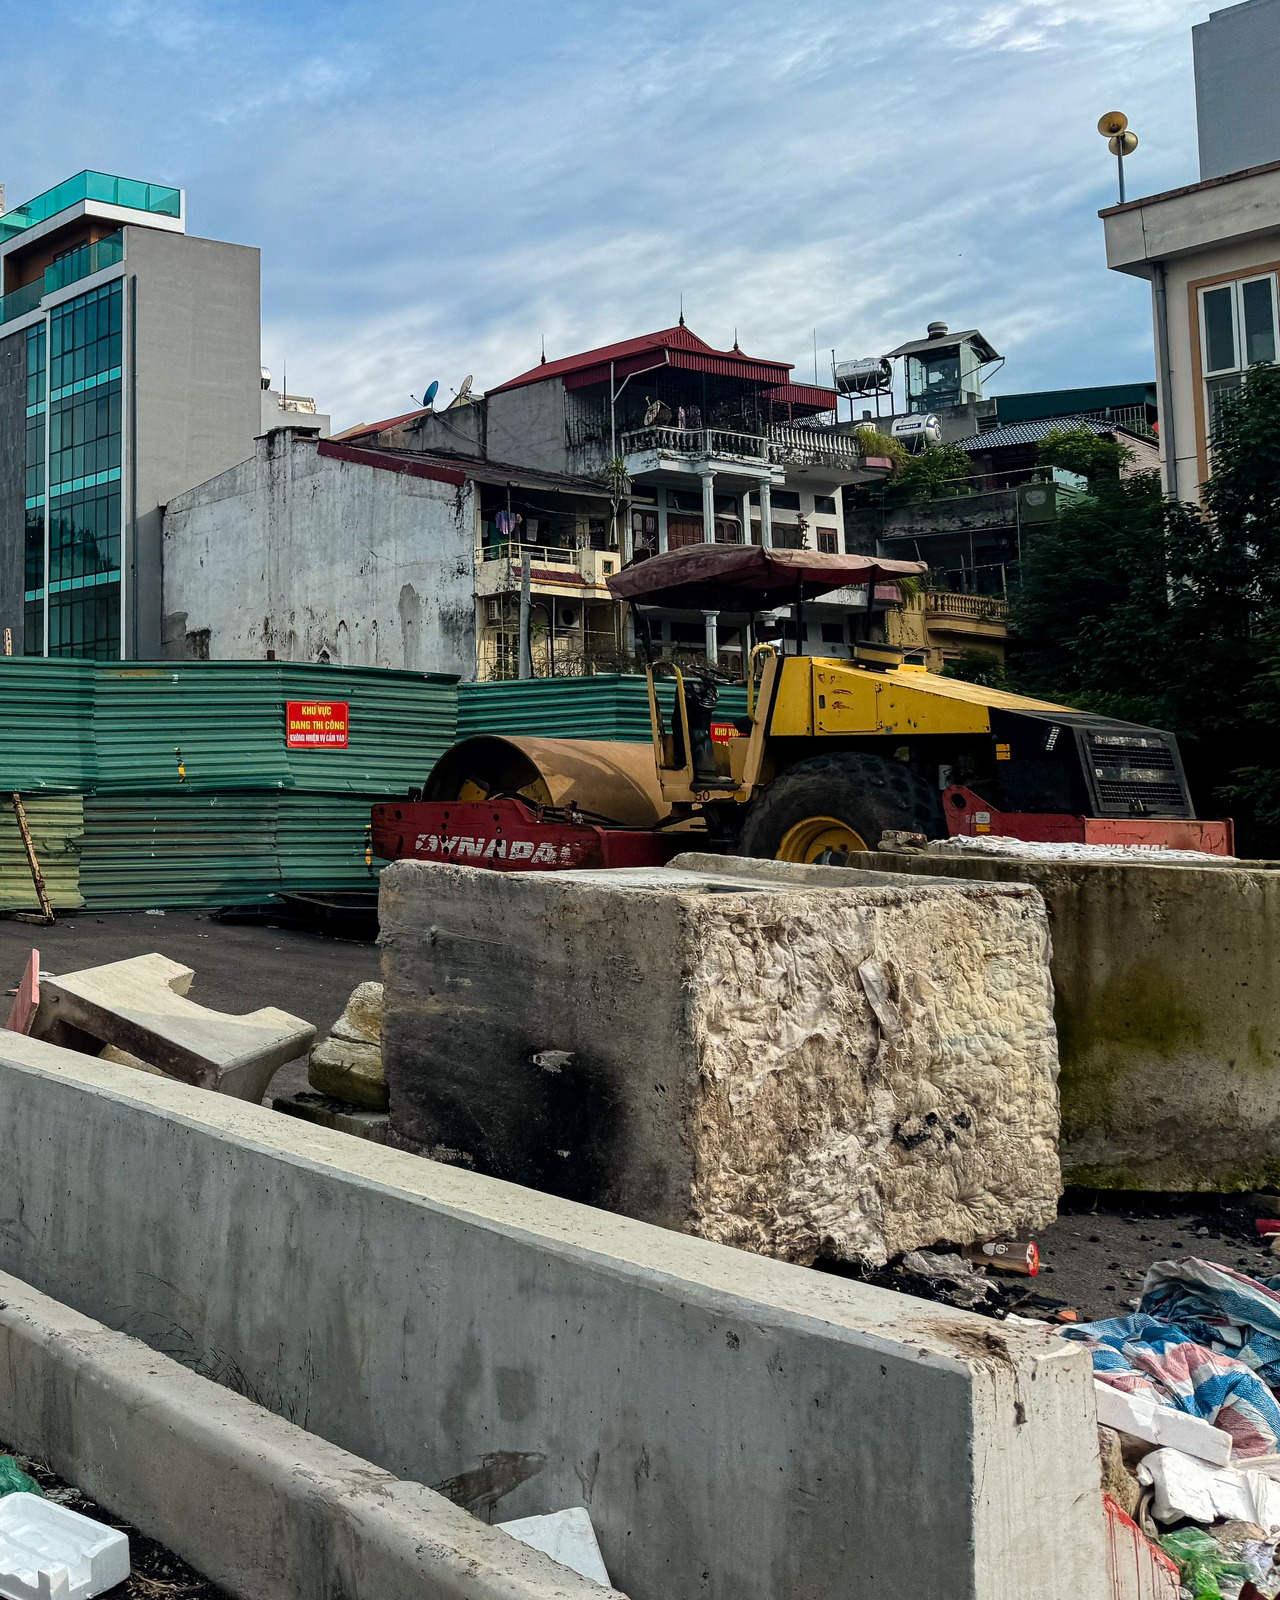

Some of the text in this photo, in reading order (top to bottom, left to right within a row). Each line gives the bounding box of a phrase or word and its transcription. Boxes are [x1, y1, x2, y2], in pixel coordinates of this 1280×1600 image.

[301, 705, 332, 717] KHU VỰC
[290, 719, 345, 730] ĐANG THI CÔNG
[714, 727, 728, 736] KHU
